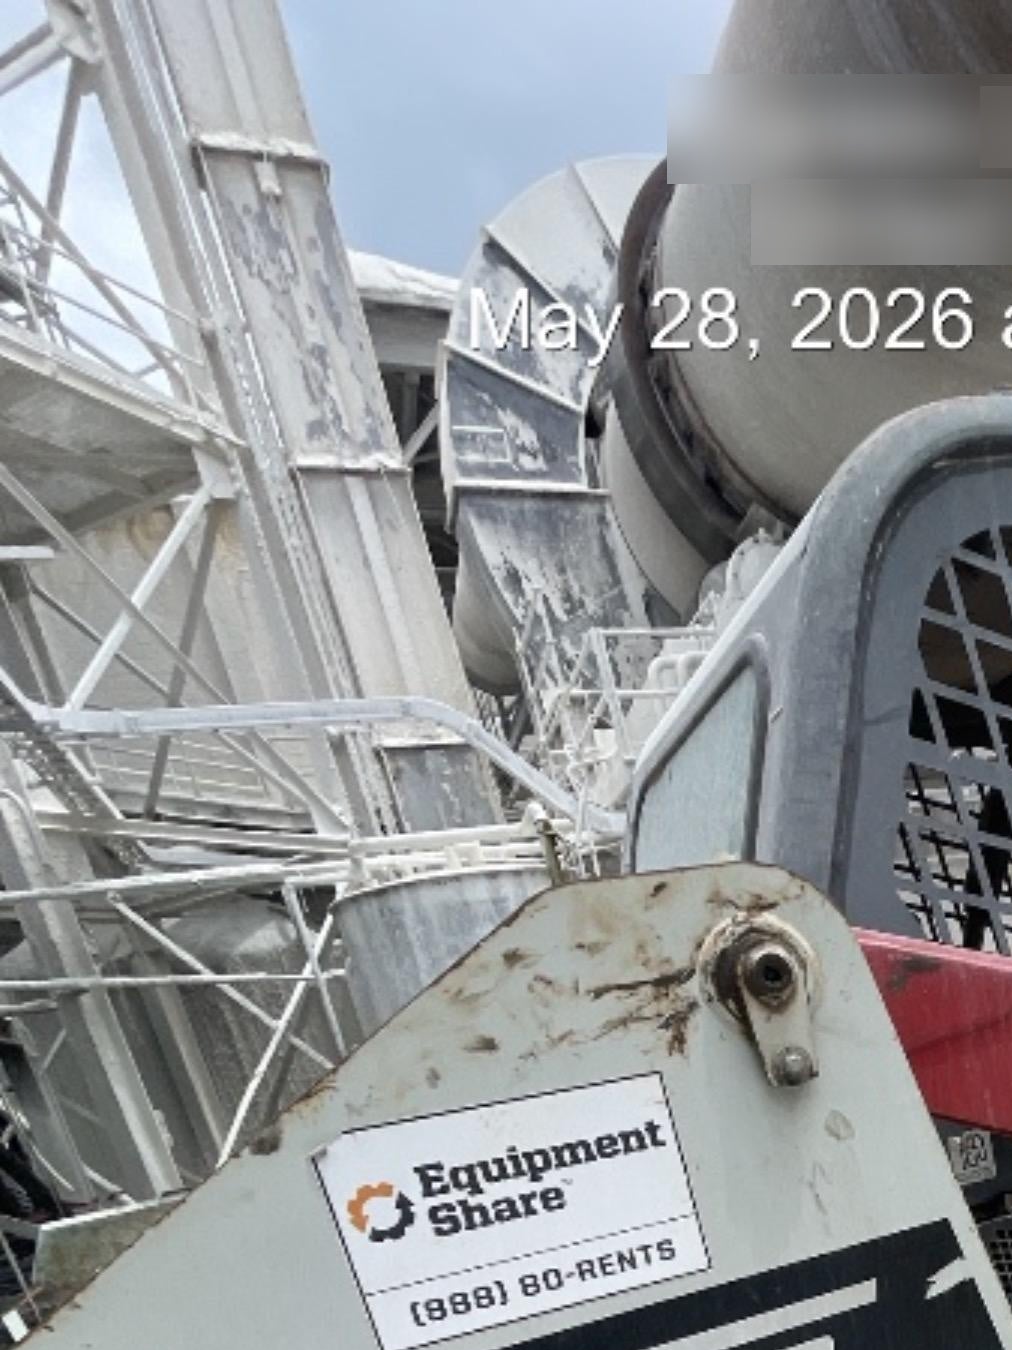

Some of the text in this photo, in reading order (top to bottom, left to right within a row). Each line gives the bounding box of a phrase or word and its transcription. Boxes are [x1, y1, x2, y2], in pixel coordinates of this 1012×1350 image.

[413, 1119, 667, 1198] Equipment
[428, 1186, 567, 1238] Share
[409, 1239, 677, 1327] (888) 80-RENTS
